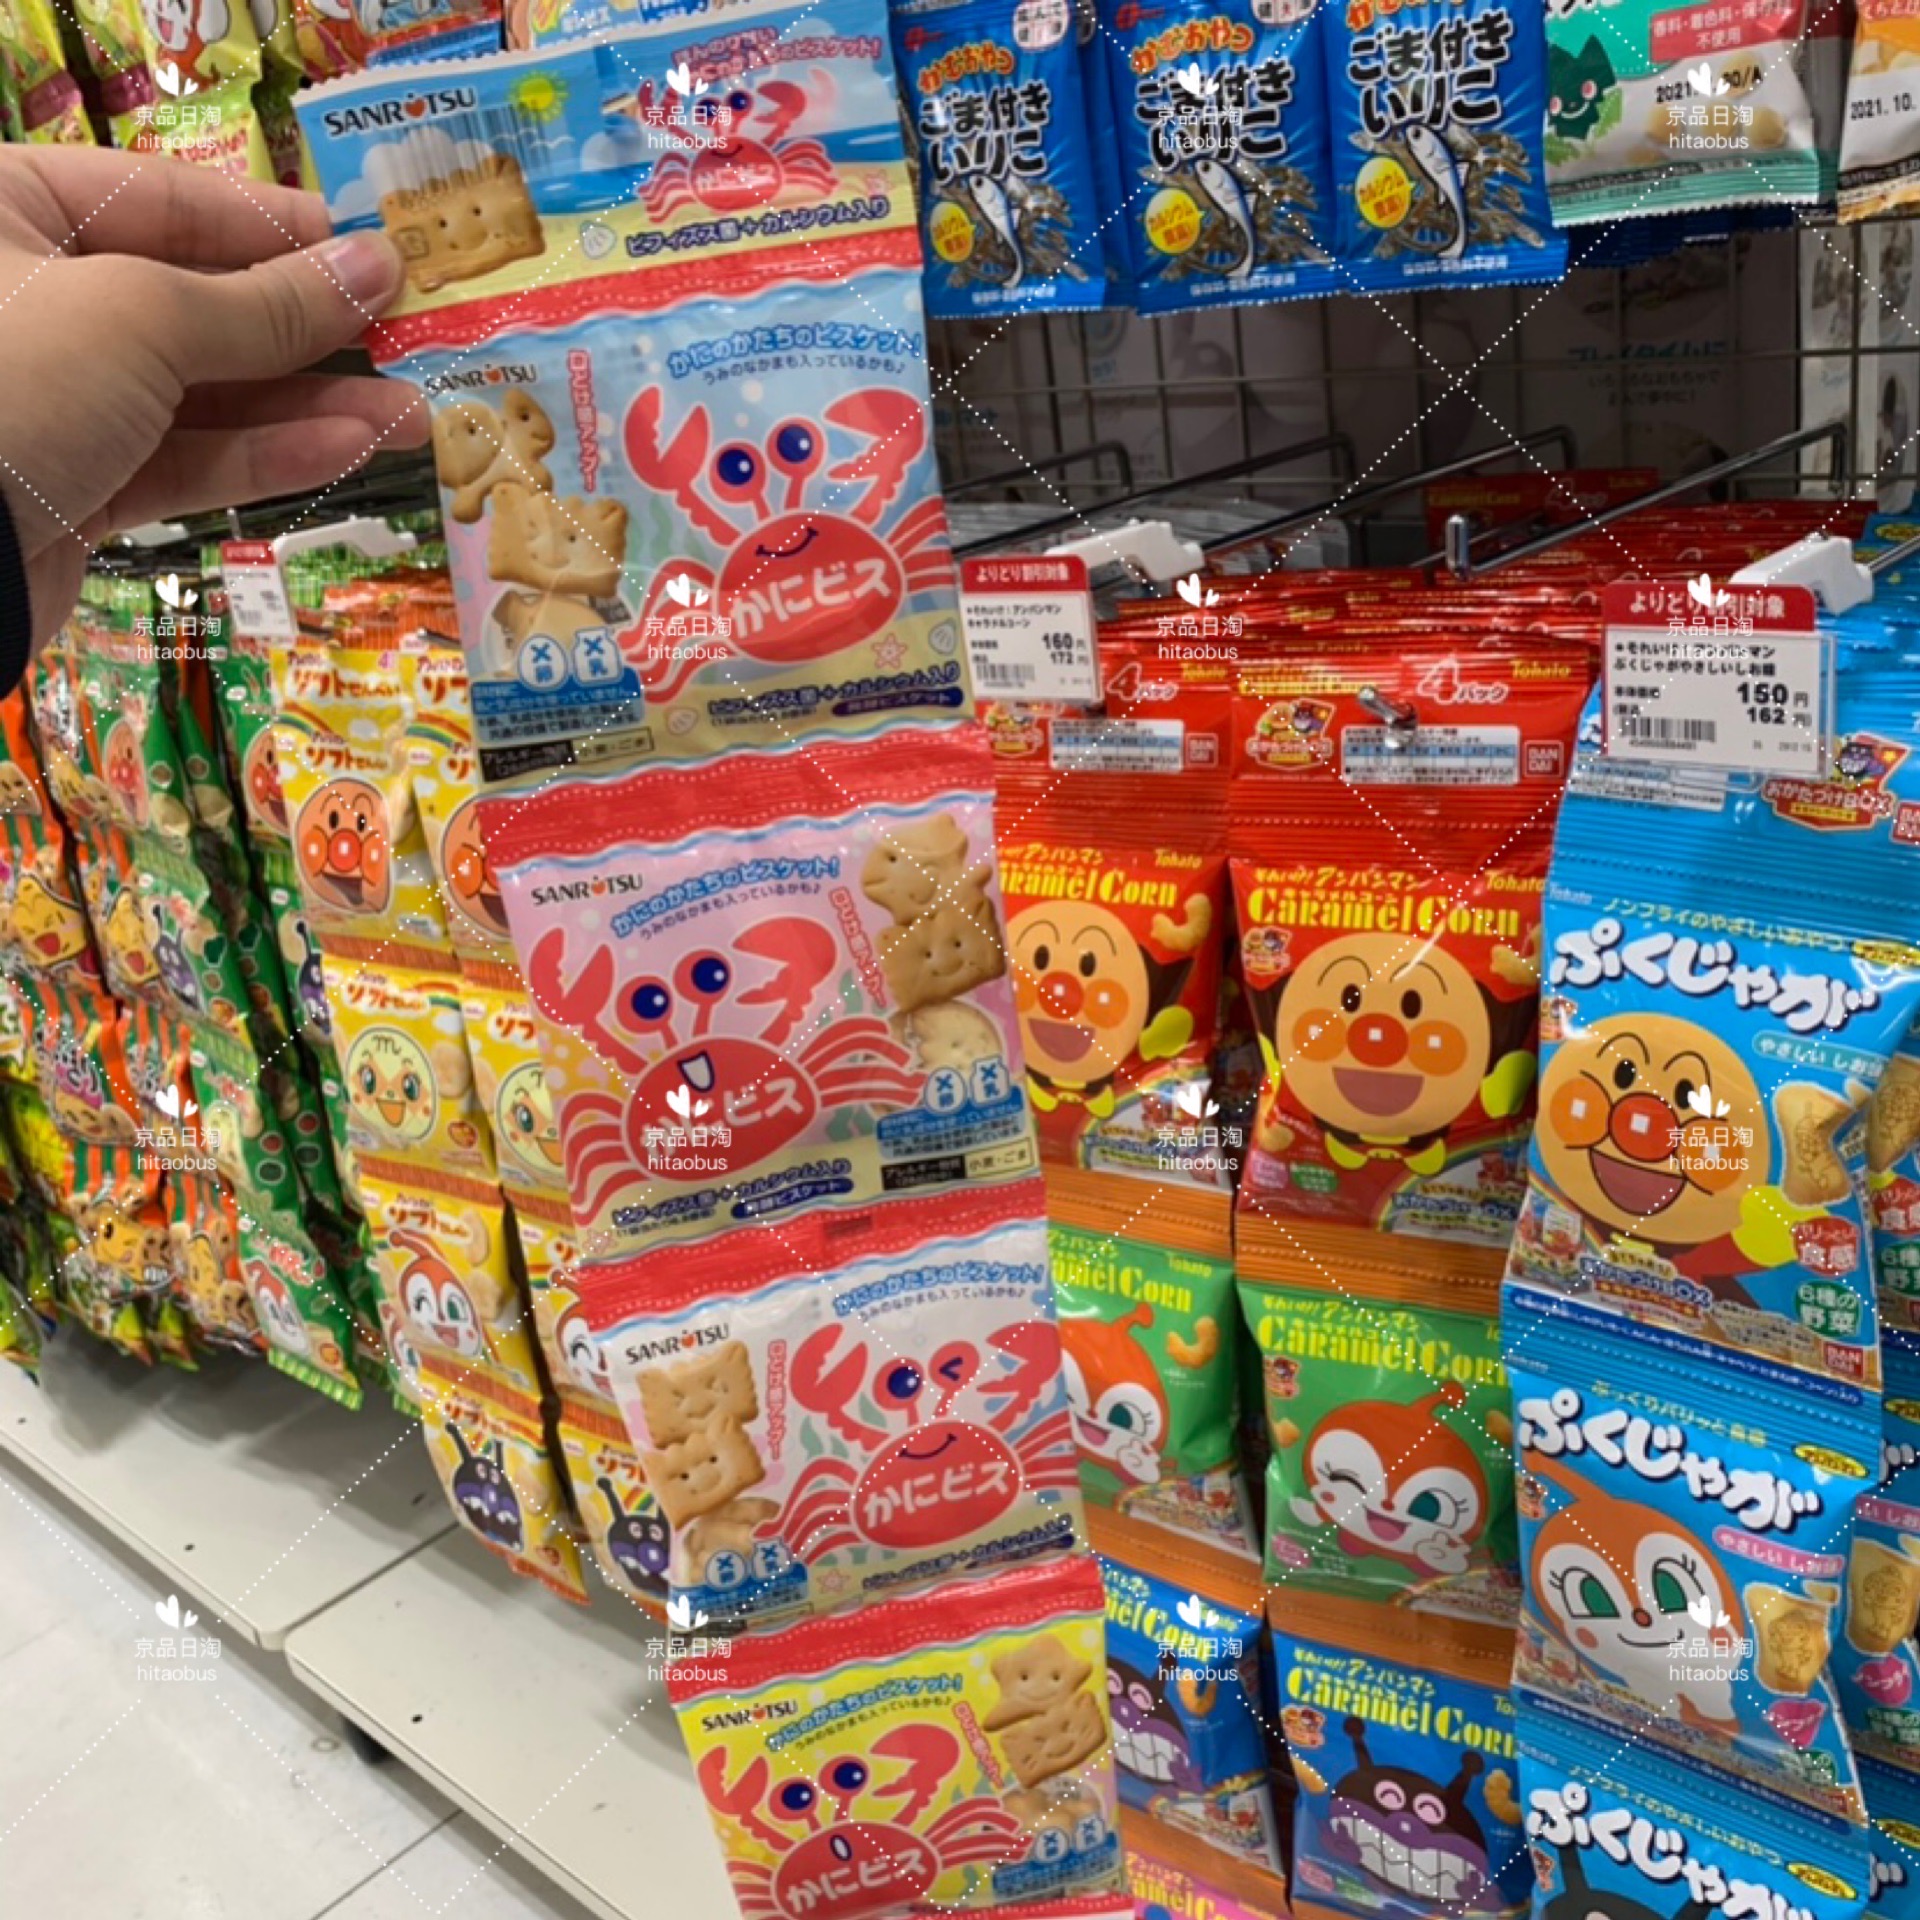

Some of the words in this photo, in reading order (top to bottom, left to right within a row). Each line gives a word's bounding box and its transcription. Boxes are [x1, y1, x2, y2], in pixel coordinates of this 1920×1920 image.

[1348, 9, 1513, 84] ごま付き
[1695, 26, 1742, 50] 不使用
[919, 79, 1051, 139] ごま付き
[1358, 67, 1502, 138] いりこ
[930, 128, 1049, 187] いりこ
[731, 557, 894, 639] かにビス
[1042, 631, 1075, 651] 160
[1049, 651, 1074, 665] 172
[1737, 681, 1789, 706] 150
[1747, 707, 1786, 725] 162
[1099, 867, 1178, 909] Corn
[1417, 894, 1521, 938] Corn
[1550, 917, 1881, 1033] ぷくじゃが
[1799, 1286, 1858, 1309] 6種の
[1518, 1387, 1823, 1533] ぷくじゃが
[863, 1461, 1011, 1531] かにビス
[785, 1848, 928, 1914] かにビス
